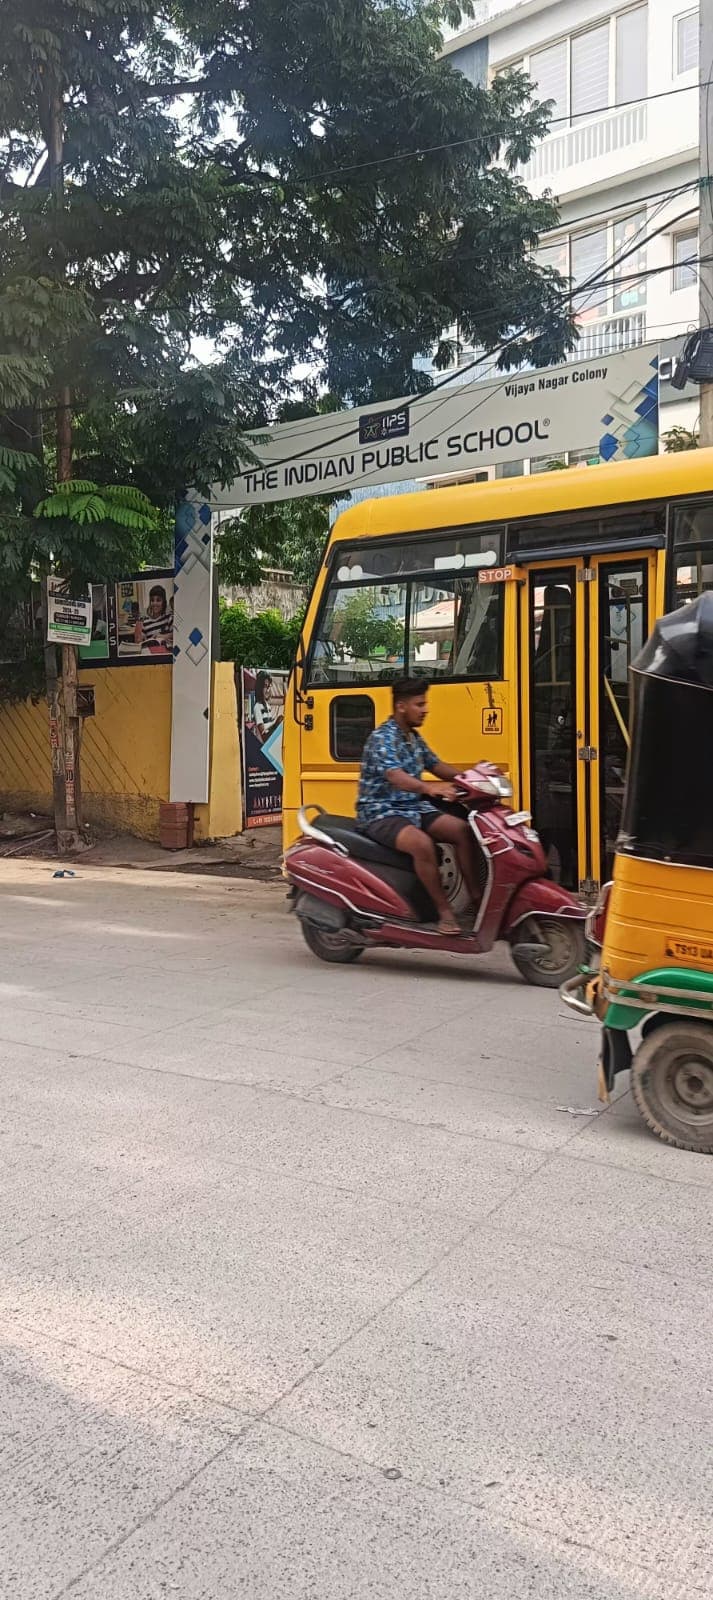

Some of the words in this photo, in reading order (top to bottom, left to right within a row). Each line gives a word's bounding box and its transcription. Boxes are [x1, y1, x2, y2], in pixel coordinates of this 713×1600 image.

[505, 382, 535, 397] Vijaya
[538, 375, 569, 391] Nagar
[571, 368, 608, 383] Colony
[243, 470, 278, 493] THE
[284, 455, 355, 486] INDIAN
[362, 440, 438, 472] PUBLIC
[479, 569, 512, 581] STOP
